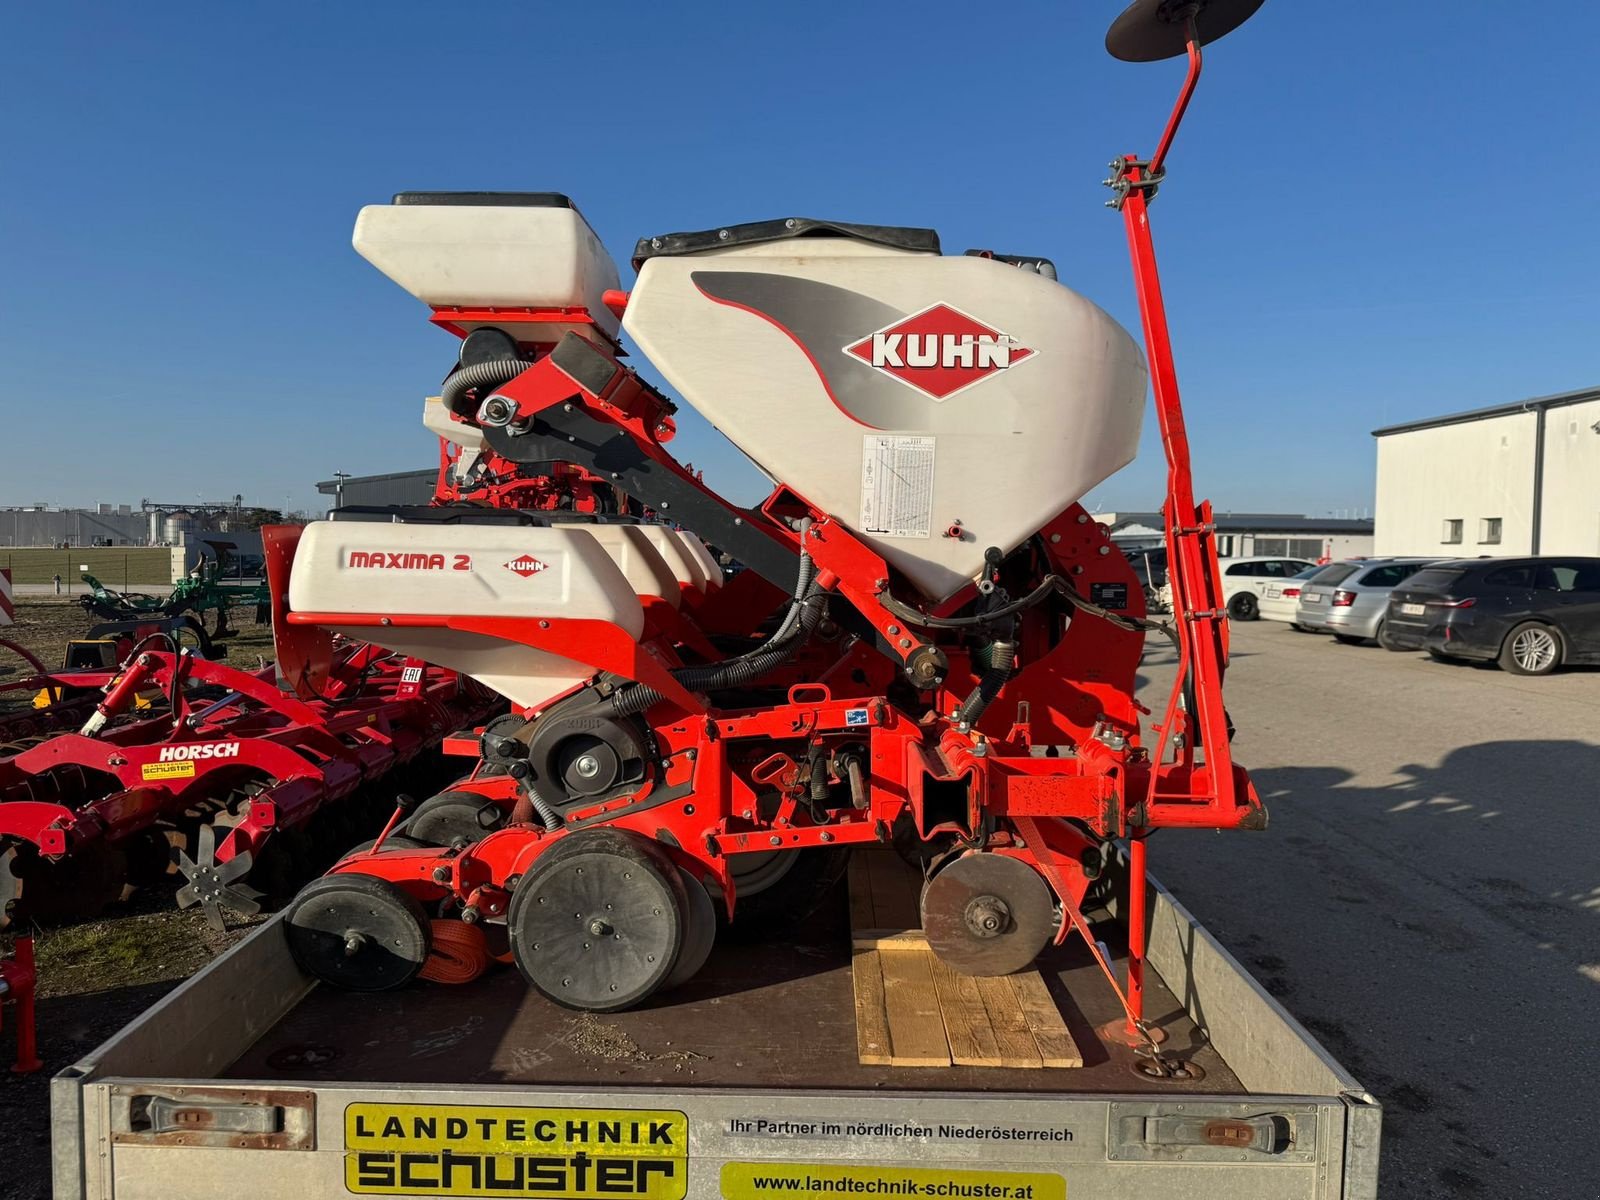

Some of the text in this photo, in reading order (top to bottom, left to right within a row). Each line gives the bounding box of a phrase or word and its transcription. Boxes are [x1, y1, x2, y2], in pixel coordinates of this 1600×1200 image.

[872, 333, 1010, 369] KUHN
[349, 551, 471, 571] MAXIMA 2
[508, 561, 544, 572] KUHN
[159, 742, 239, 762] HORSCH
[356, 1115, 674, 1145] LANDTECHNIK
[730, 1119, 1074, 1142] Ihr Partner im nördlichen Niederösterreich
[358, 1150, 674, 1193] schuster
[753, 1175, 1033, 1200] www.landtechnik-schuster.at
